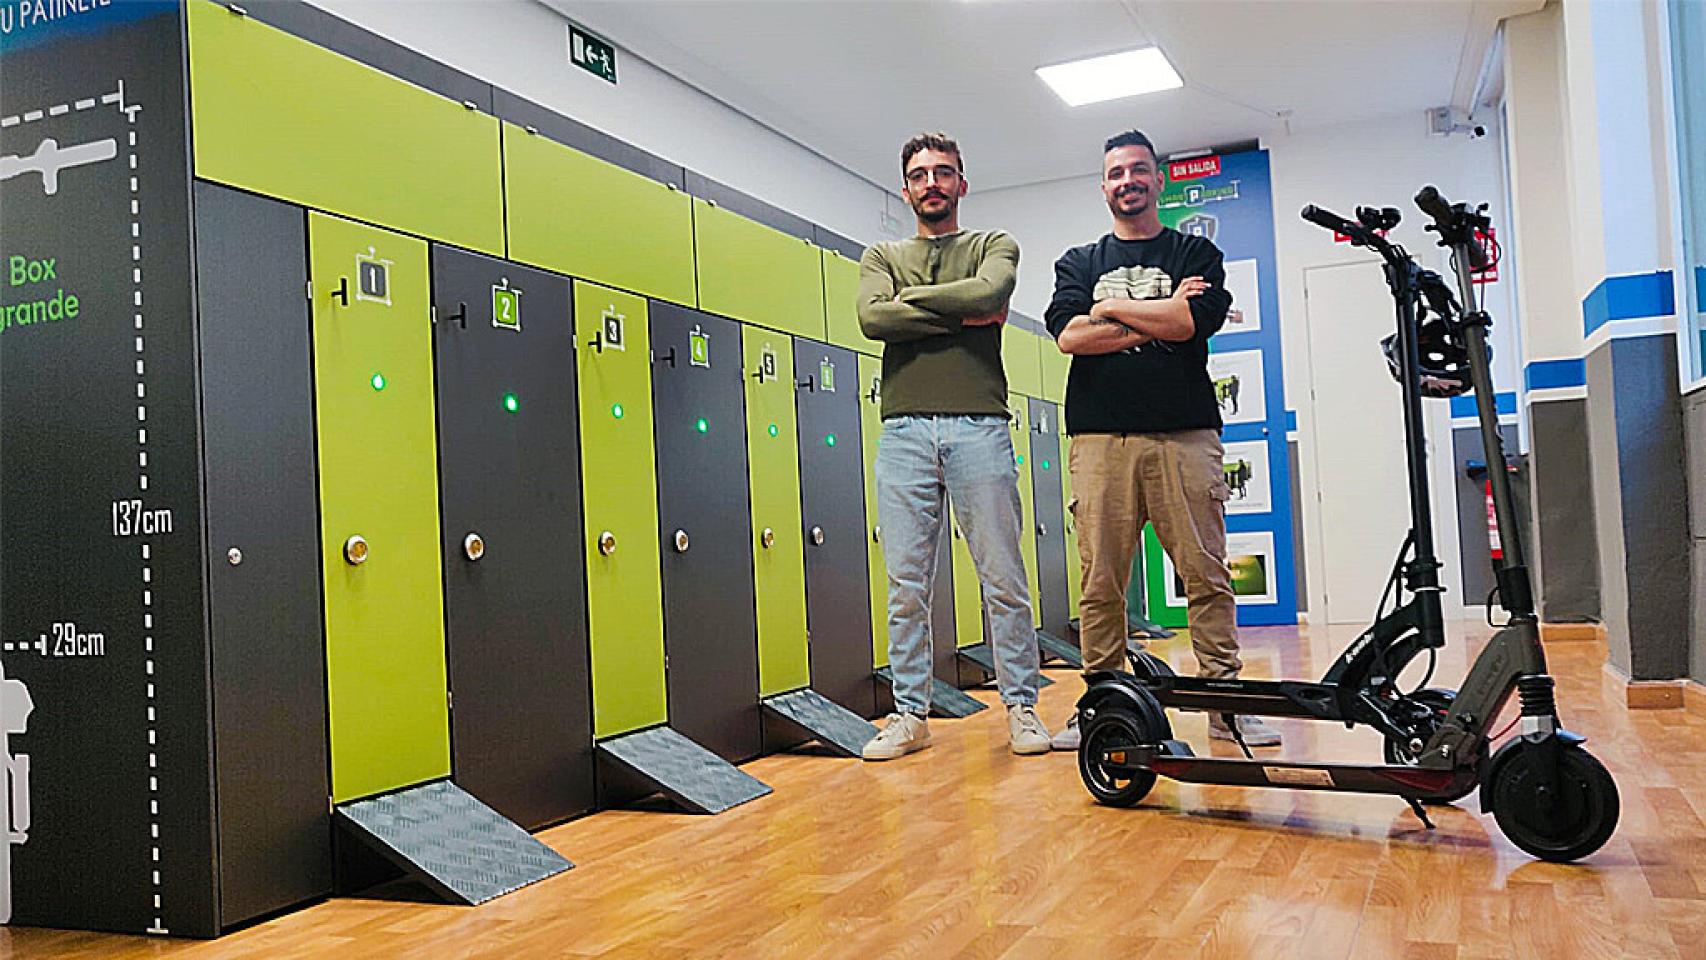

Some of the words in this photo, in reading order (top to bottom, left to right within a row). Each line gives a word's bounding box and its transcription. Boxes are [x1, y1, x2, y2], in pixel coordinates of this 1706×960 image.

[19, 0, 111, 28] PATIN
[9, 255, 56, 286] Box
[369, 267, 377, 293] 1
[501, 297, 511, 319] 2
[608, 321, 618, 342] 3
[765, 355, 773, 374] 5
[112, 499, 173, 536] 137cm
[52, 622, 105, 656] 29cm
